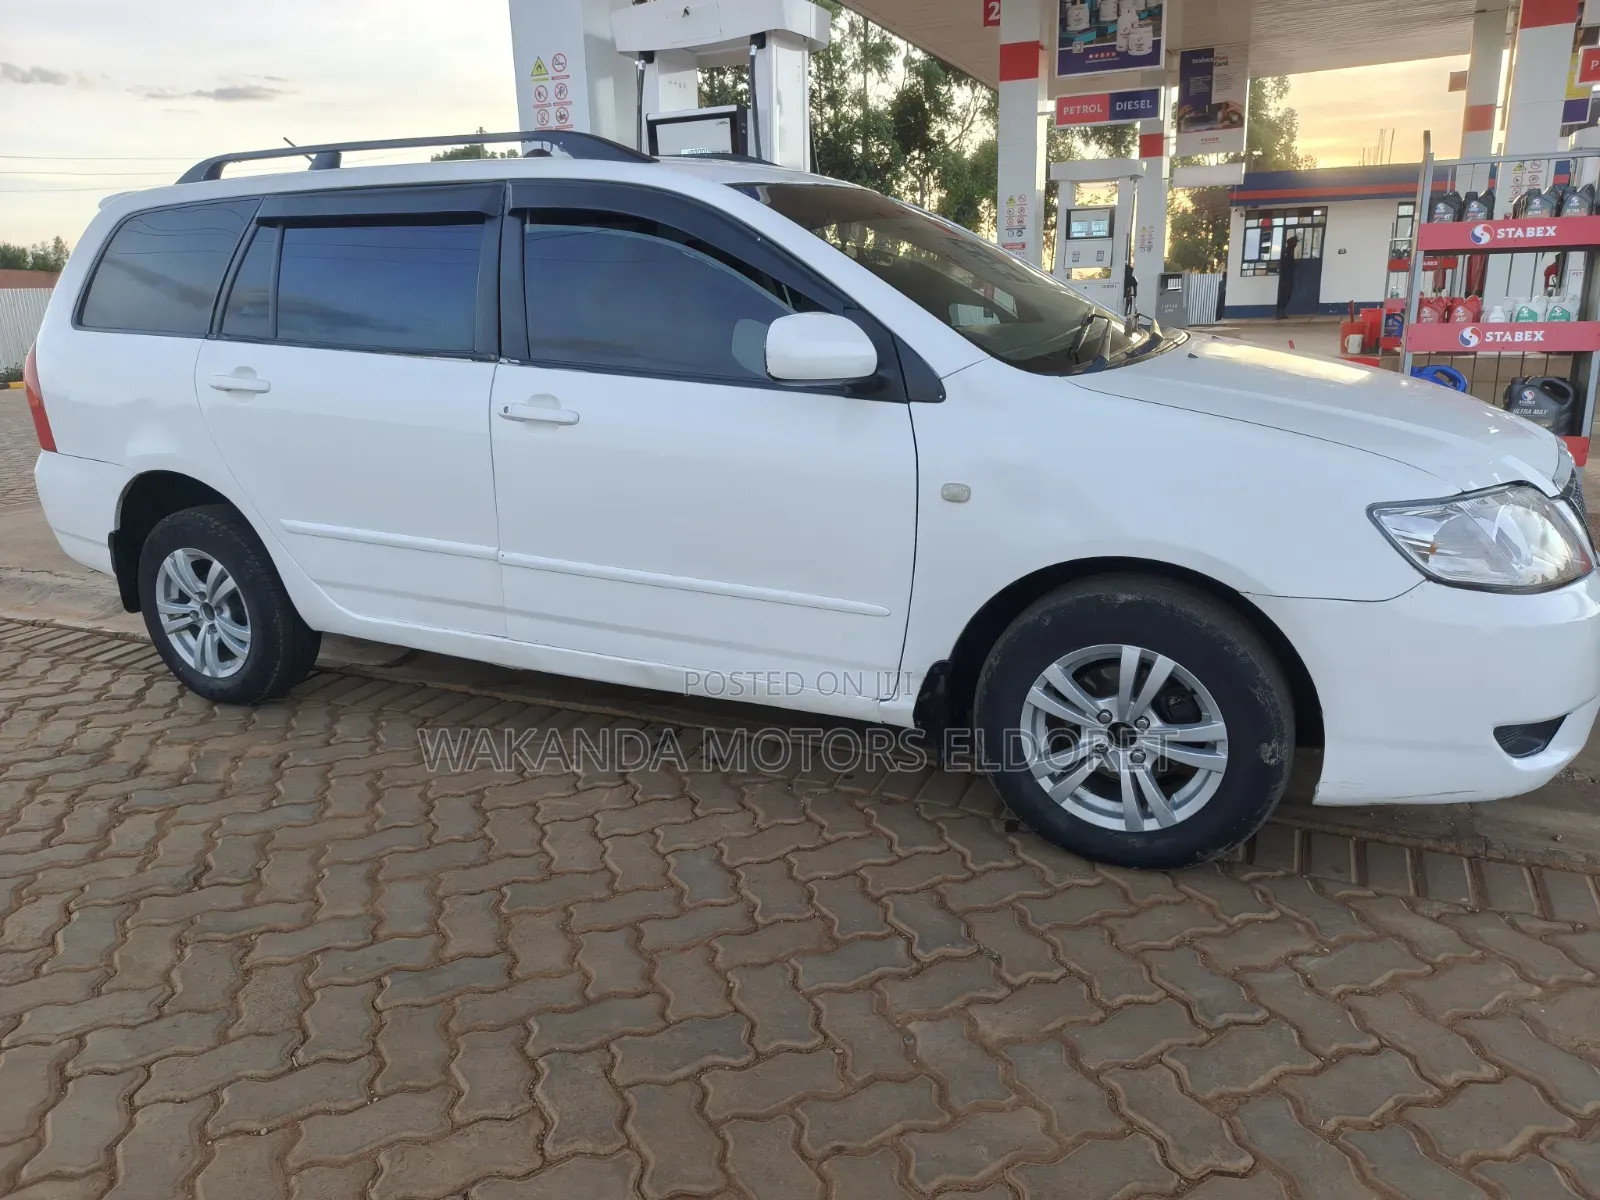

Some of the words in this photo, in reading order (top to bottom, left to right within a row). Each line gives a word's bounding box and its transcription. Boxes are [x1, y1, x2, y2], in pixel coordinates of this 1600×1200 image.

[988, 1, 1000, 20] 2
[1063, 103, 1103, 115] PETROL
[1115, 99, 1153, 111] DIESEL
[1496, 225, 1557, 239] STABEX
[1484, 330, 1545, 342] STABEX
